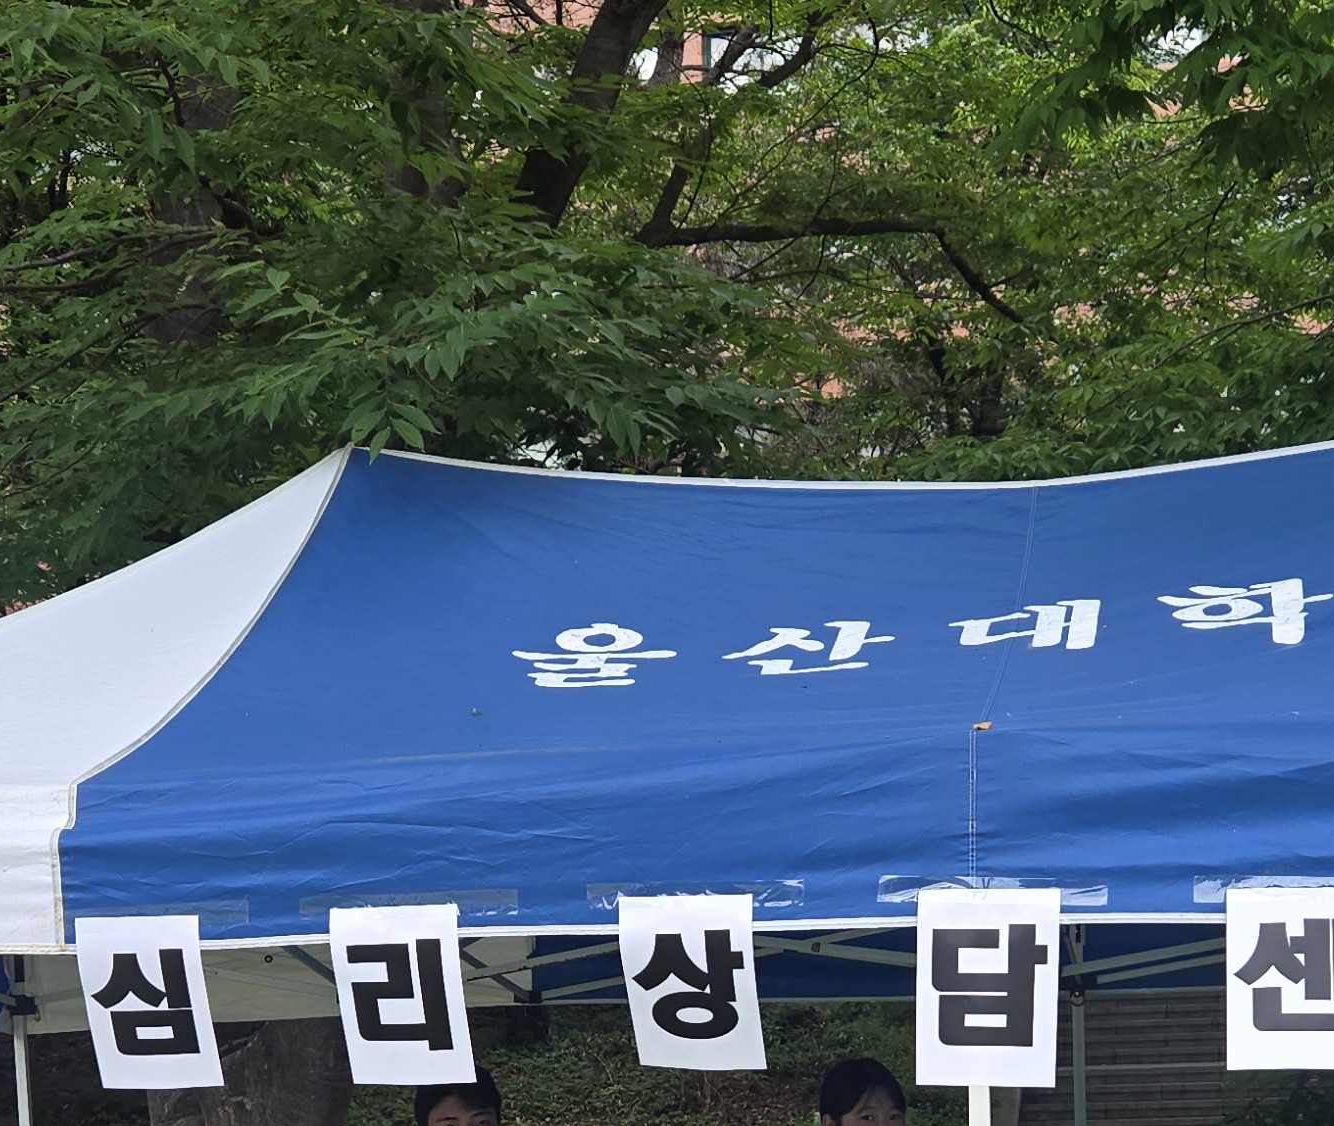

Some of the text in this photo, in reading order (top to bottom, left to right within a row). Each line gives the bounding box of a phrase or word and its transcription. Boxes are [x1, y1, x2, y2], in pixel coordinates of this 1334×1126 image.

[91, 948, 202, 1056] 심
[345, 939, 453, 1052] 리
[633, 928, 745, 1041] 상
[931, 923, 1049, 1048] 담
